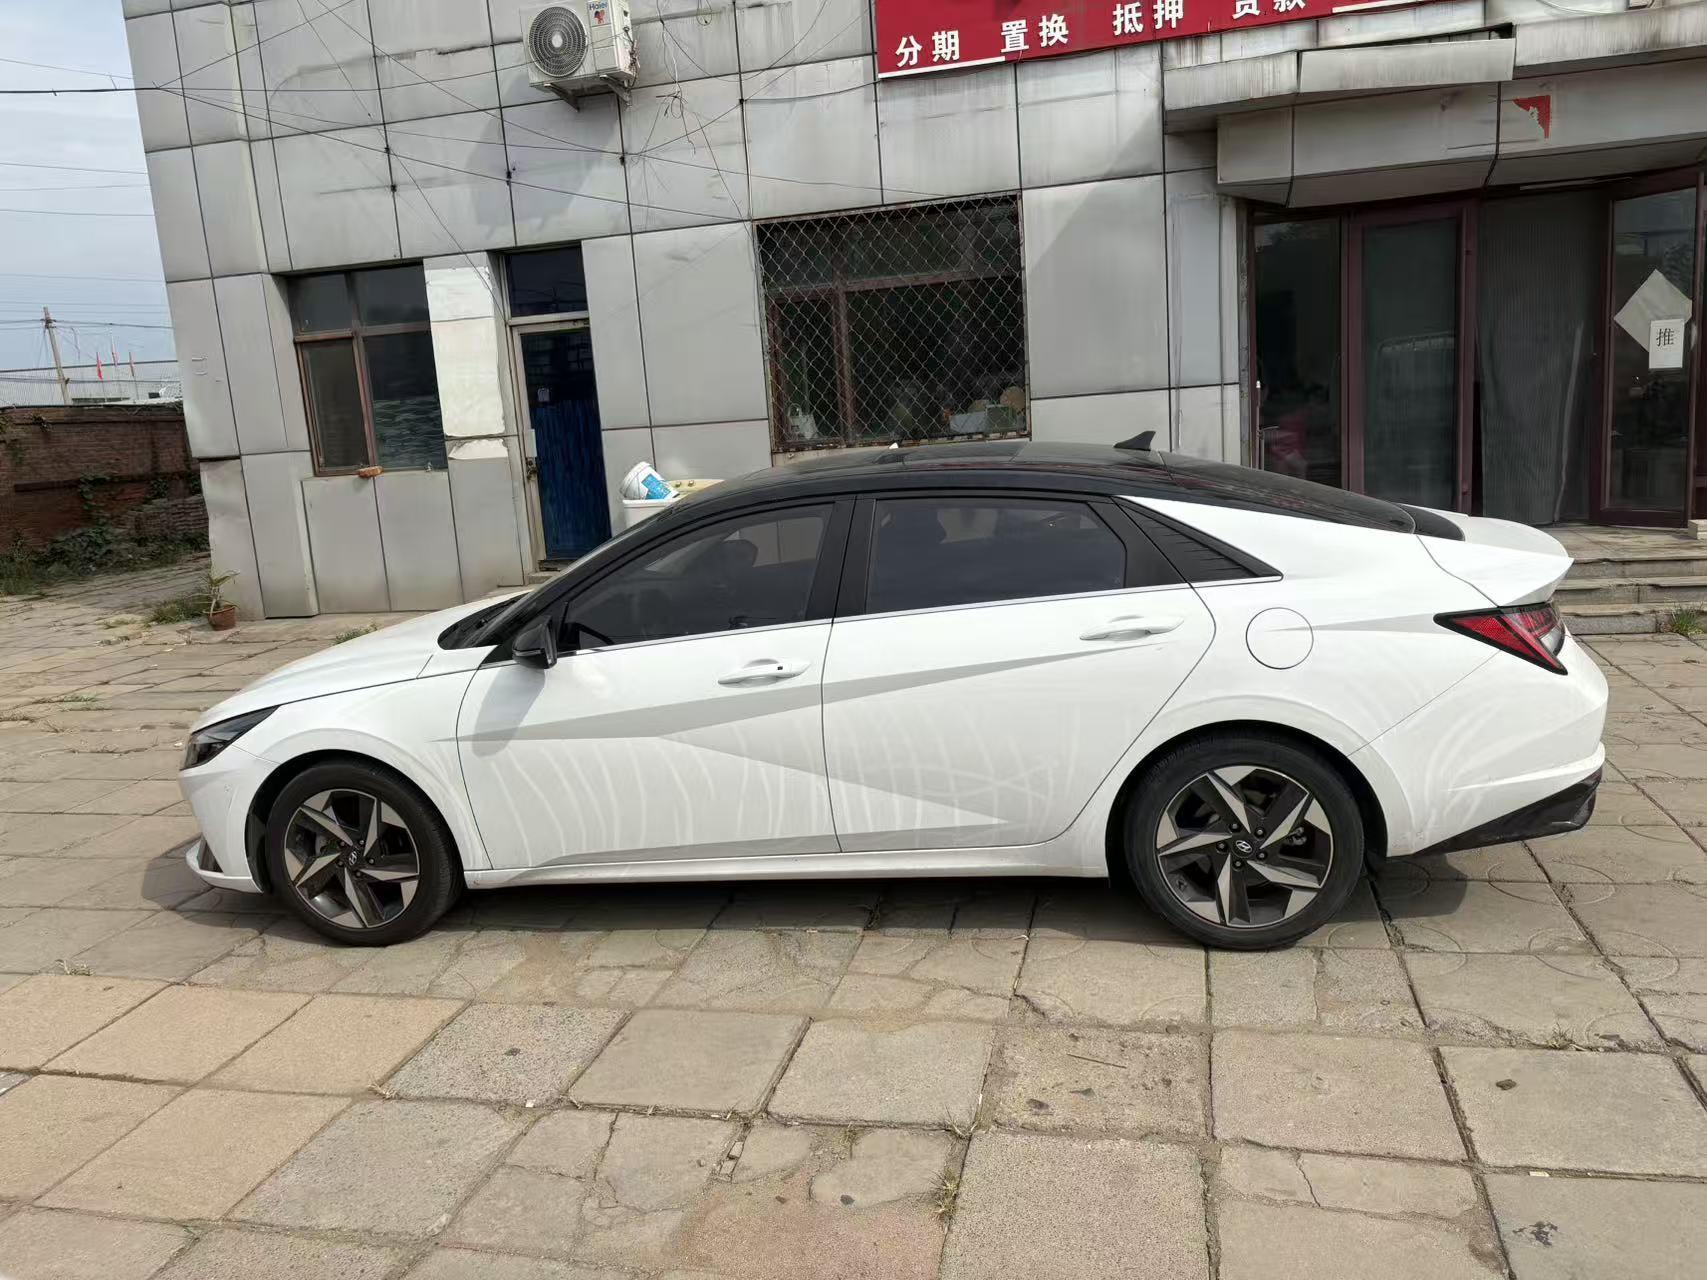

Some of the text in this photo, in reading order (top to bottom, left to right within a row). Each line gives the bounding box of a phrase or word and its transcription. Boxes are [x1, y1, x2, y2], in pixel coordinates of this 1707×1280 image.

[895, 30, 960, 67] 分期
[1000, 13, 1069, 53] 置换
[1112, 0, 1184, 36] 抵押
[1656, 328, 1675, 347] 推
